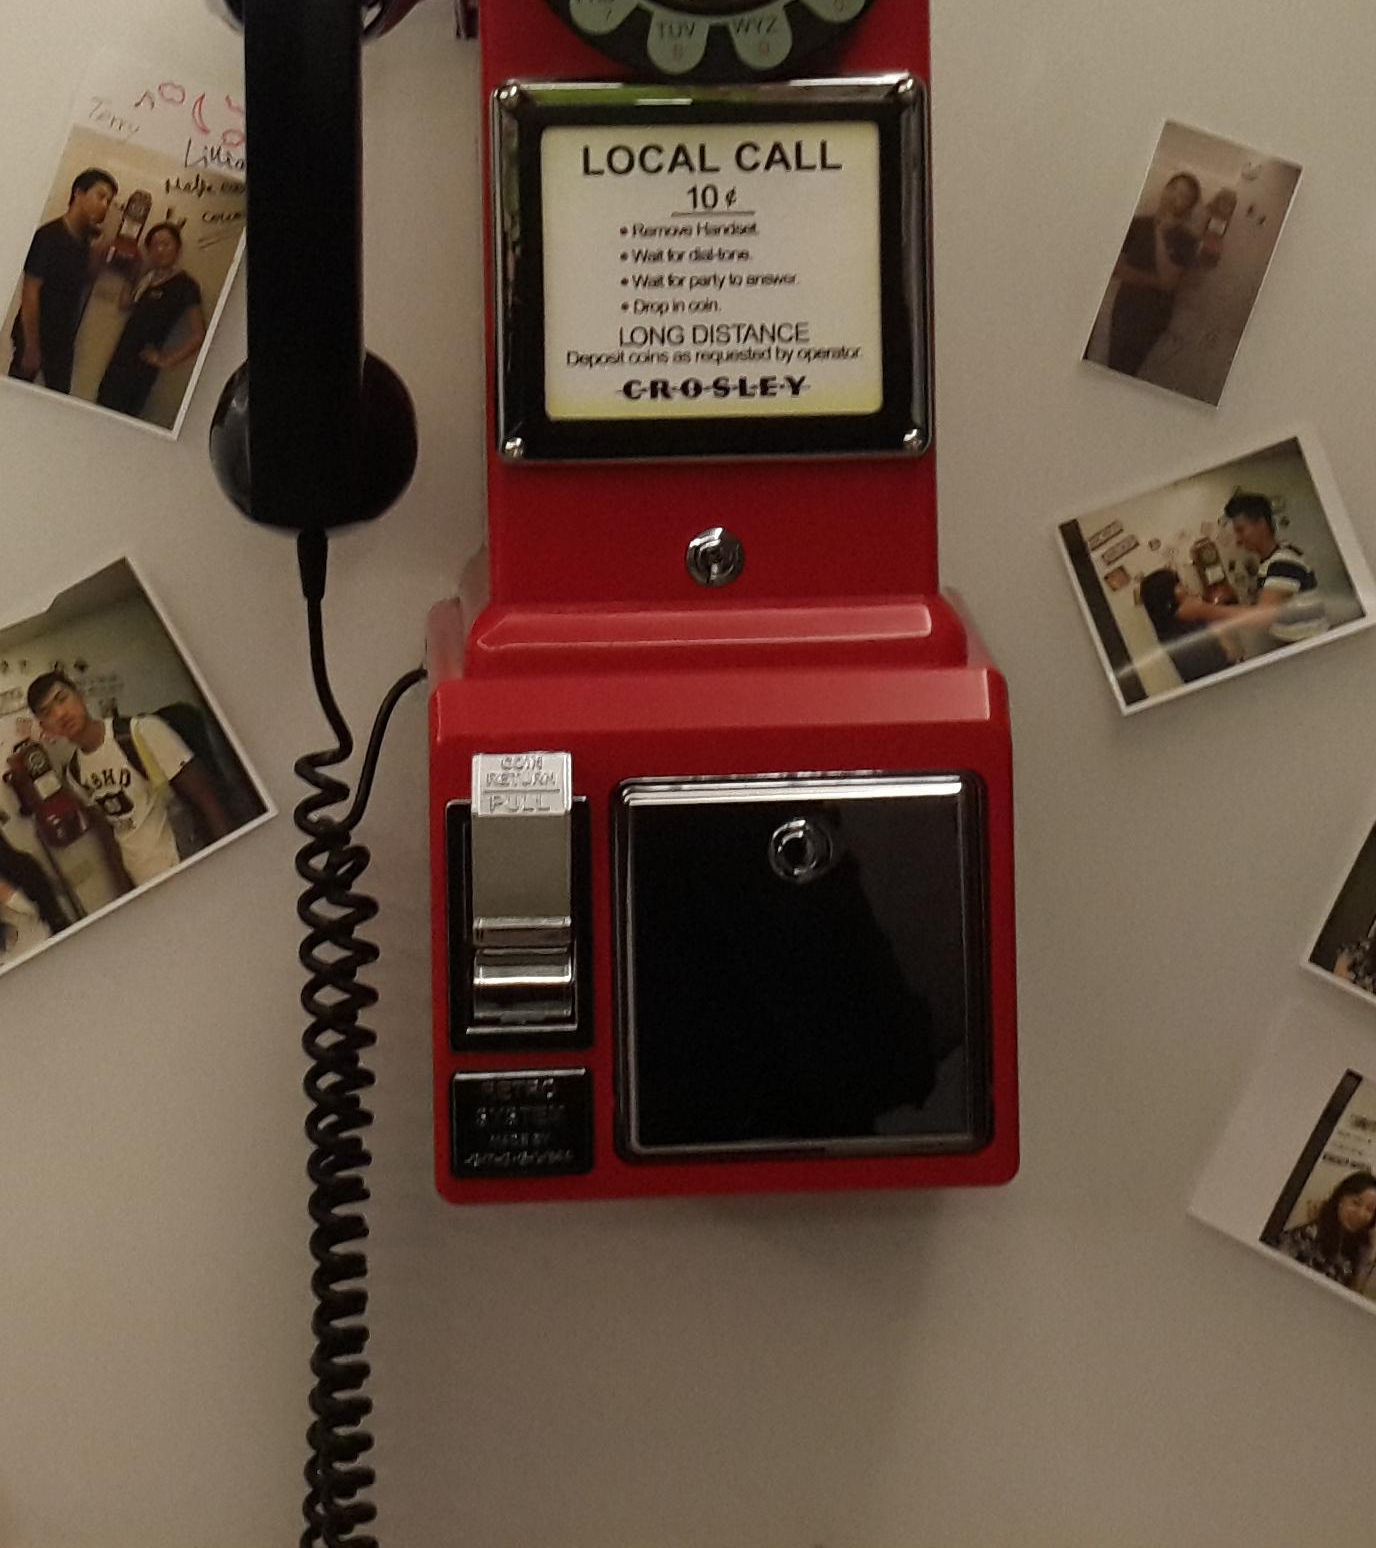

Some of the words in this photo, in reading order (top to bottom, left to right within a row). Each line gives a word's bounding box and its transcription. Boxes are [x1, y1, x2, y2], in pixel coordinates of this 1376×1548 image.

[581, 142, 721, 177] LOCAL
[735, 139, 843, 173] CALL
[686, 184, 719, 210] 10
[632, 222, 693, 238] Remove
[697, 221, 760, 237] Handset.
[632, 248, 664, 263] Wait
[667, 247, 685, 262] for
[632, 273, 664, 289] Wait
[667, 272, 686, 287] for
[689, 272, 727, 291] party
[729, 273, 743, 287] to
[746, 273, 800, 287] answer.
[633, 298, 669, 317] Drop
[672, 298, 685, 313] in
[688, 297, 722, 313] coin.
[619, 324, 685, 348] LONG
[692, 321, 811, 345] DISTANCE
[566, 349, 625, 370] Deposit
[629, 350, 669, 365] coins
[673, 350, 692, 364] as
[695, 346, 772, 366] requested
[775, 345, 793, 364] by
[500, 755, 544, 771] COIN
[485, 771, 557, 788] RETURN
[488, 794, 552, 814] PULL
